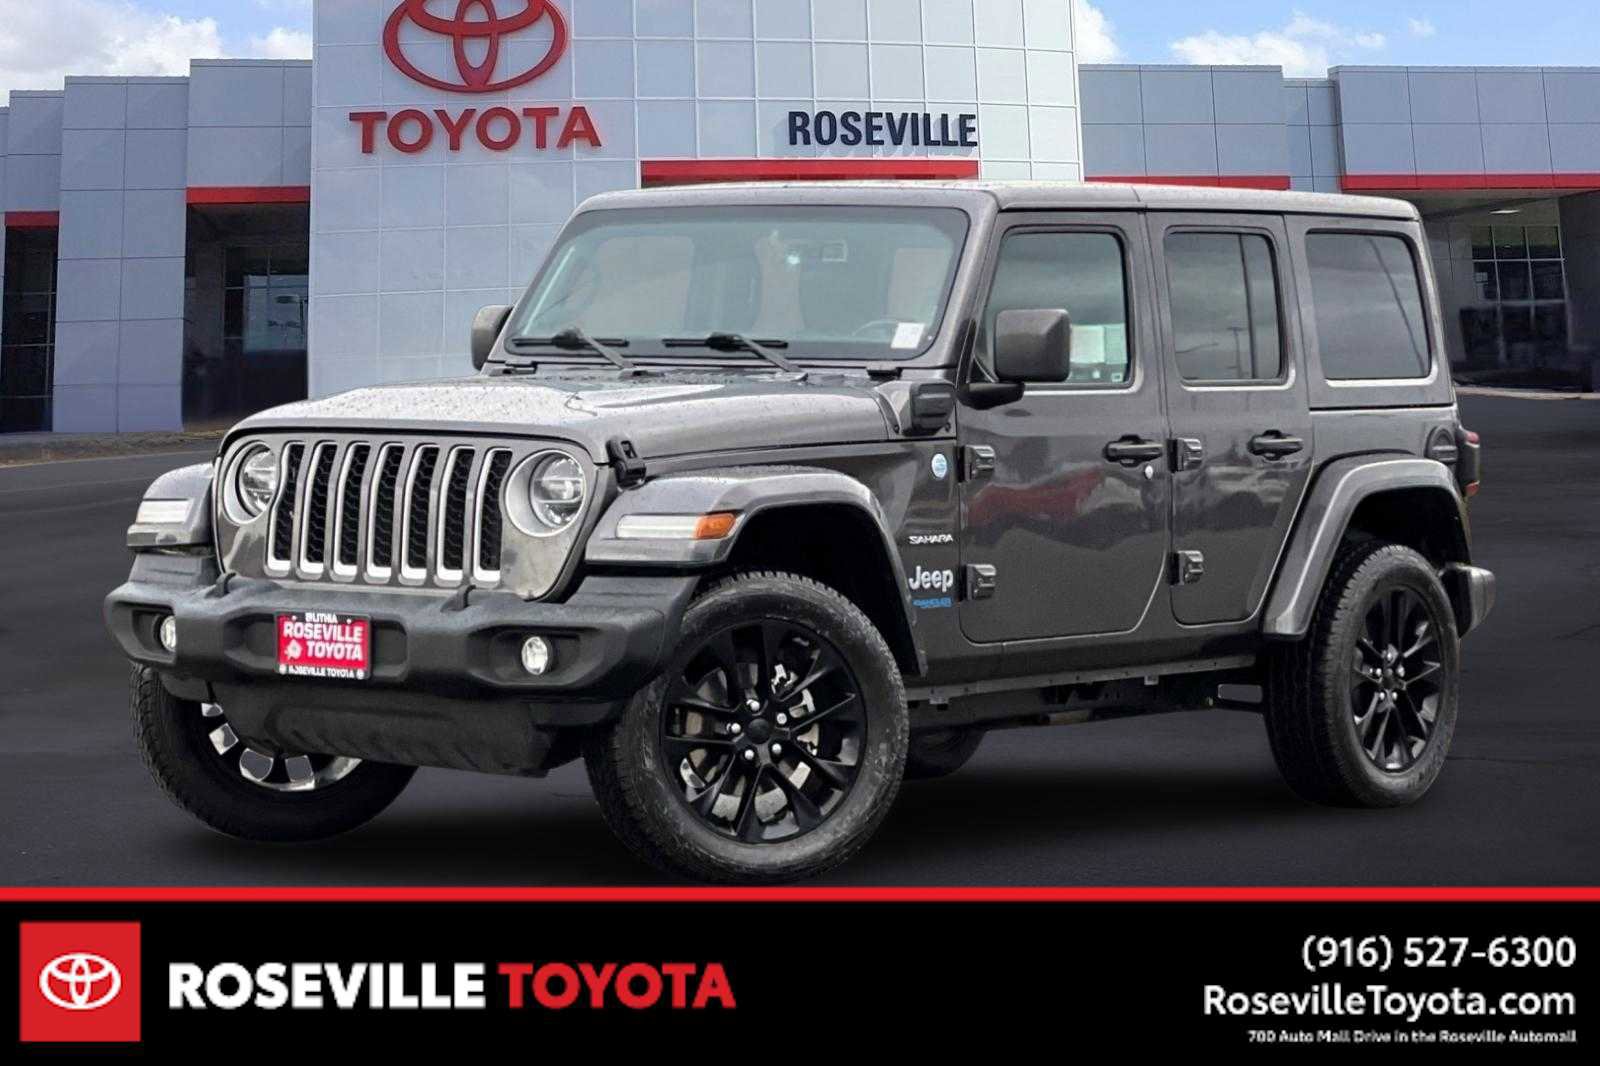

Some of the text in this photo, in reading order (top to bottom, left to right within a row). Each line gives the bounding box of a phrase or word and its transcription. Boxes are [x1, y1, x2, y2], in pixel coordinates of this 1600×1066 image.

[349, 106, 602, 154] TOYOTA
[788, 110, 978, 147] ROSEVILLE
[908, 533, 954, 545] SAHARA
[908, 565, 954, 593] Jeep
[283, 621, 363, 643] ROSEVILLE
[306, 640, 363, 661] TOYOTA
[326, 667, 355, 679] TOYOTA
